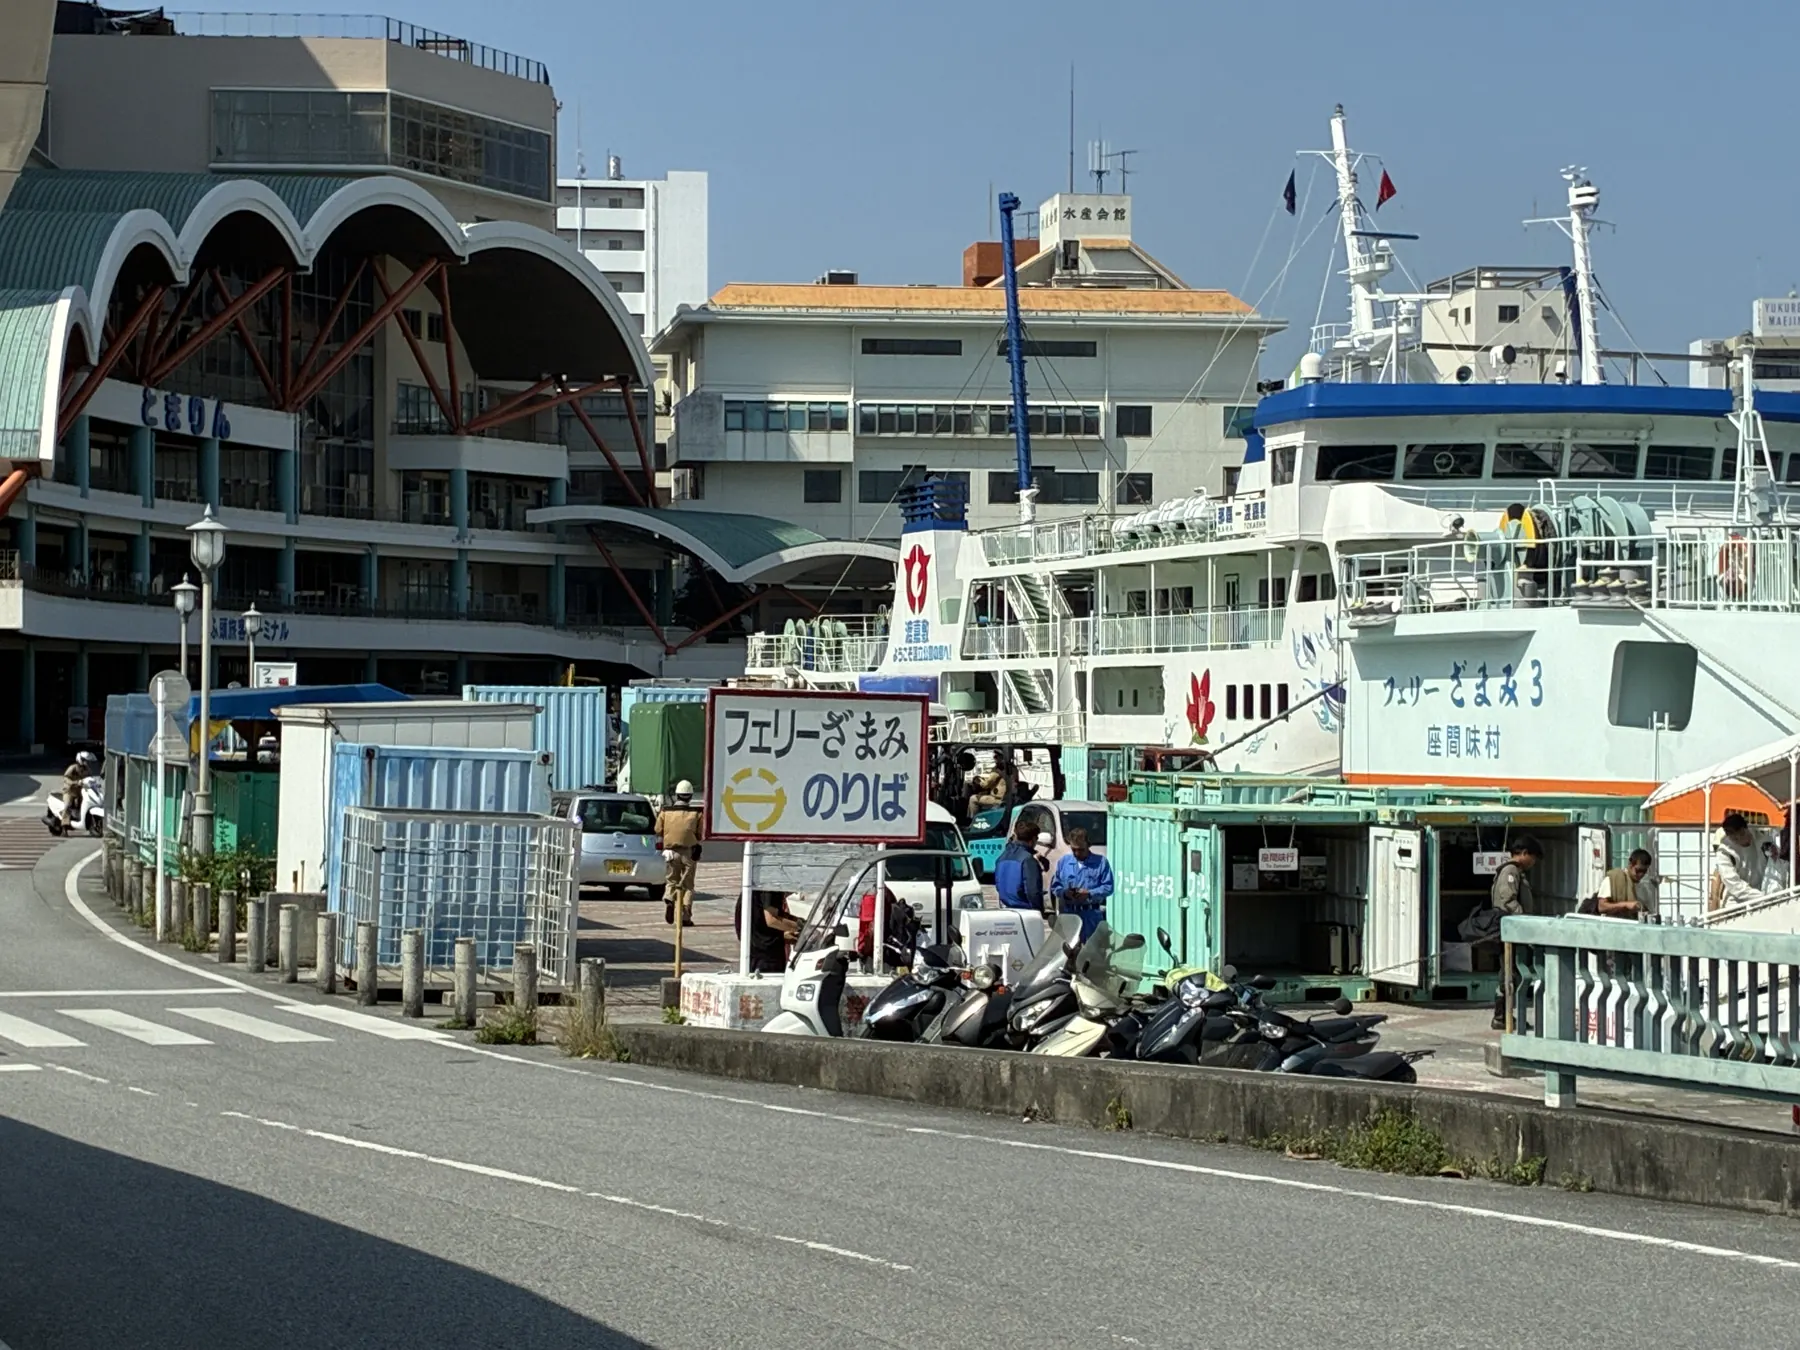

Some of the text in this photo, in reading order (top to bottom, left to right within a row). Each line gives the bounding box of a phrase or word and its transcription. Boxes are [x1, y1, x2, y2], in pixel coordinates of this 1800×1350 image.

[1063, 206, 1126, 221] 水産会館
[141, 387, 231, 440] とまりん
[725, 708, 910, 760] フェリーざまみ
[1427, 724, 1500, 759] 座間味村
[803, 772, 910, 822] のりば
